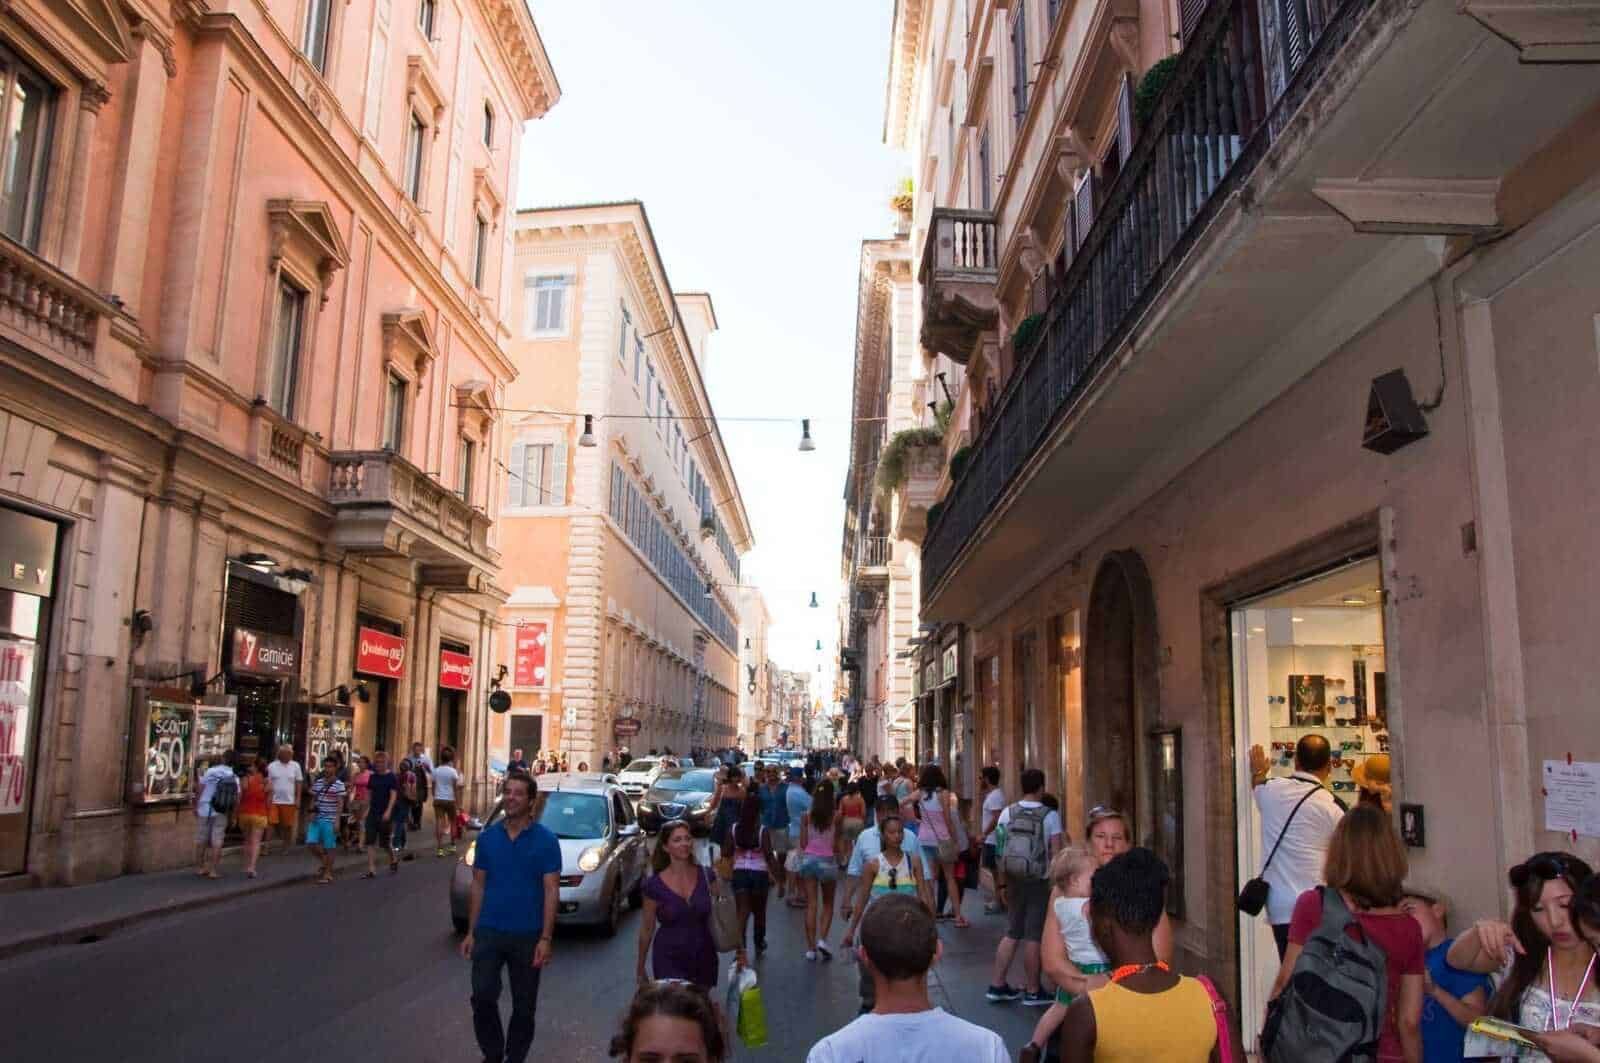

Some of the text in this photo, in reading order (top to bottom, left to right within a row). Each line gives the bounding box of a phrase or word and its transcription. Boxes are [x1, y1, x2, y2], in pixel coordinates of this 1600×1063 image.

[257, 646, 294, 668] camicie
[152, 736, 185, 780] 50
[309, 740, 328, 773] 50
